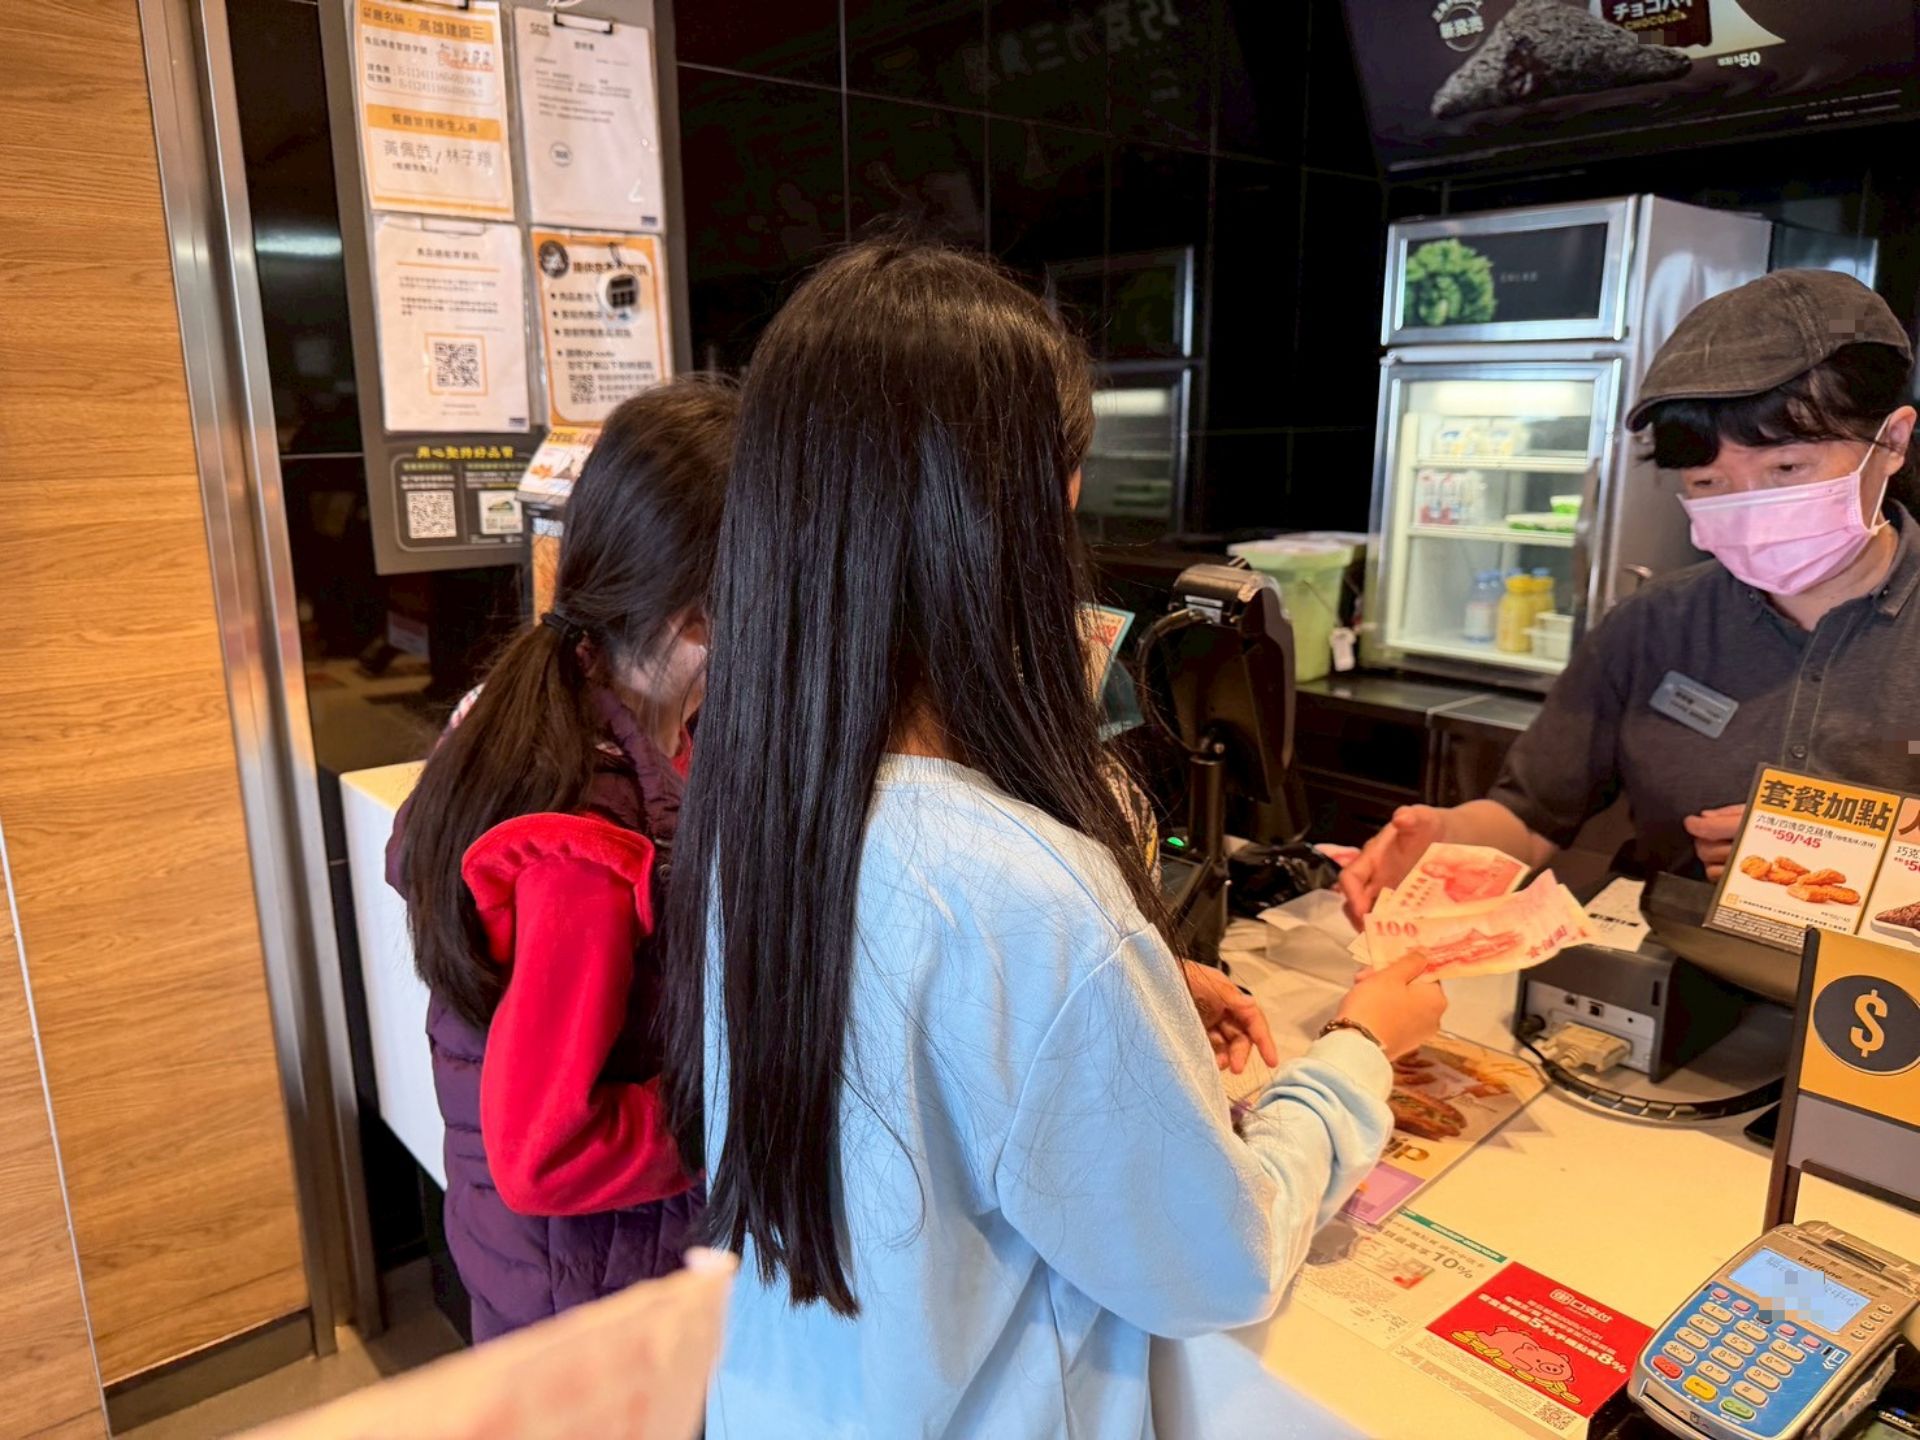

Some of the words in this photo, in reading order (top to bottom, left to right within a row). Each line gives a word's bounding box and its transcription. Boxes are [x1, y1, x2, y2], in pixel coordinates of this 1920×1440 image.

[1760, 779, 1893, 832] 套餐加點
[1895, 845, 1920, 860] 巧克
[1374, 920, 1419, 939] 100
